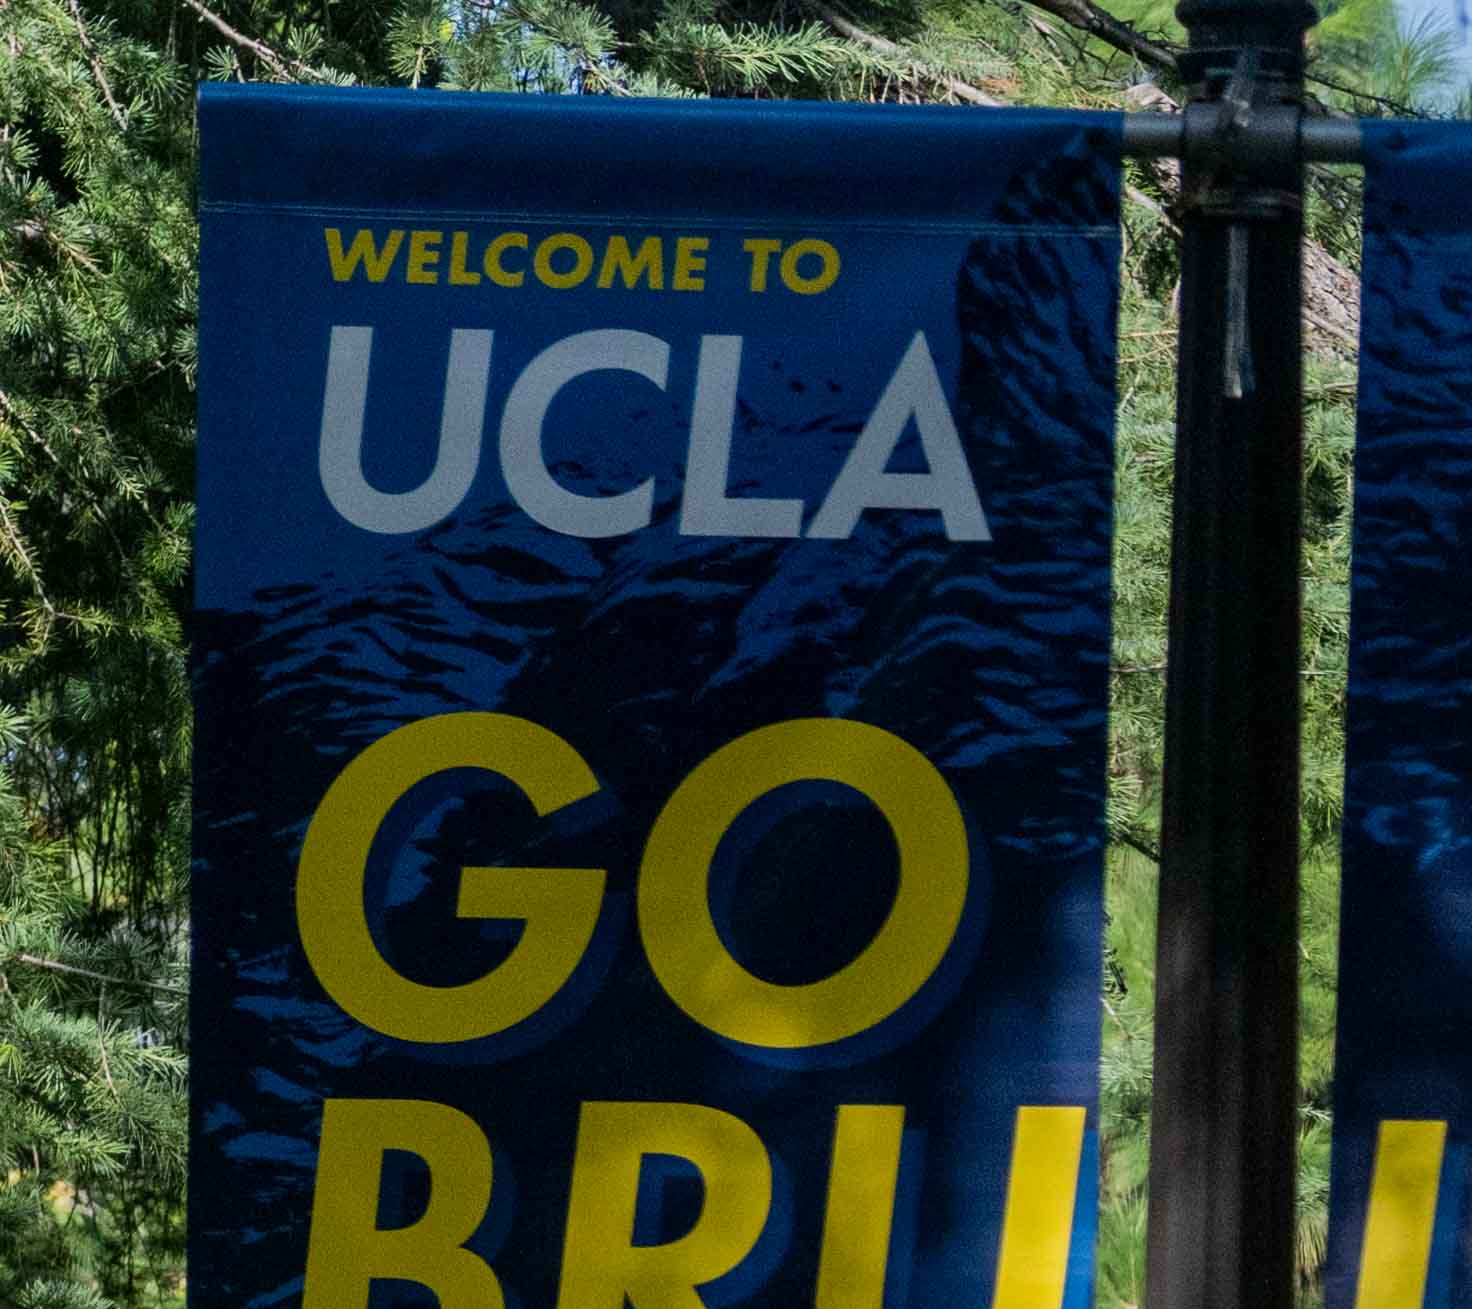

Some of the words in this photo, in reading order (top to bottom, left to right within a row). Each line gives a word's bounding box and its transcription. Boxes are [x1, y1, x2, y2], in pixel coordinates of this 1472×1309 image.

[324, 227, 709, 291] WELCOME
[743, 238, 841, 295] TO
[318, 324, 993, 542] UCLA
[294, 711, 970, 1050] GO
